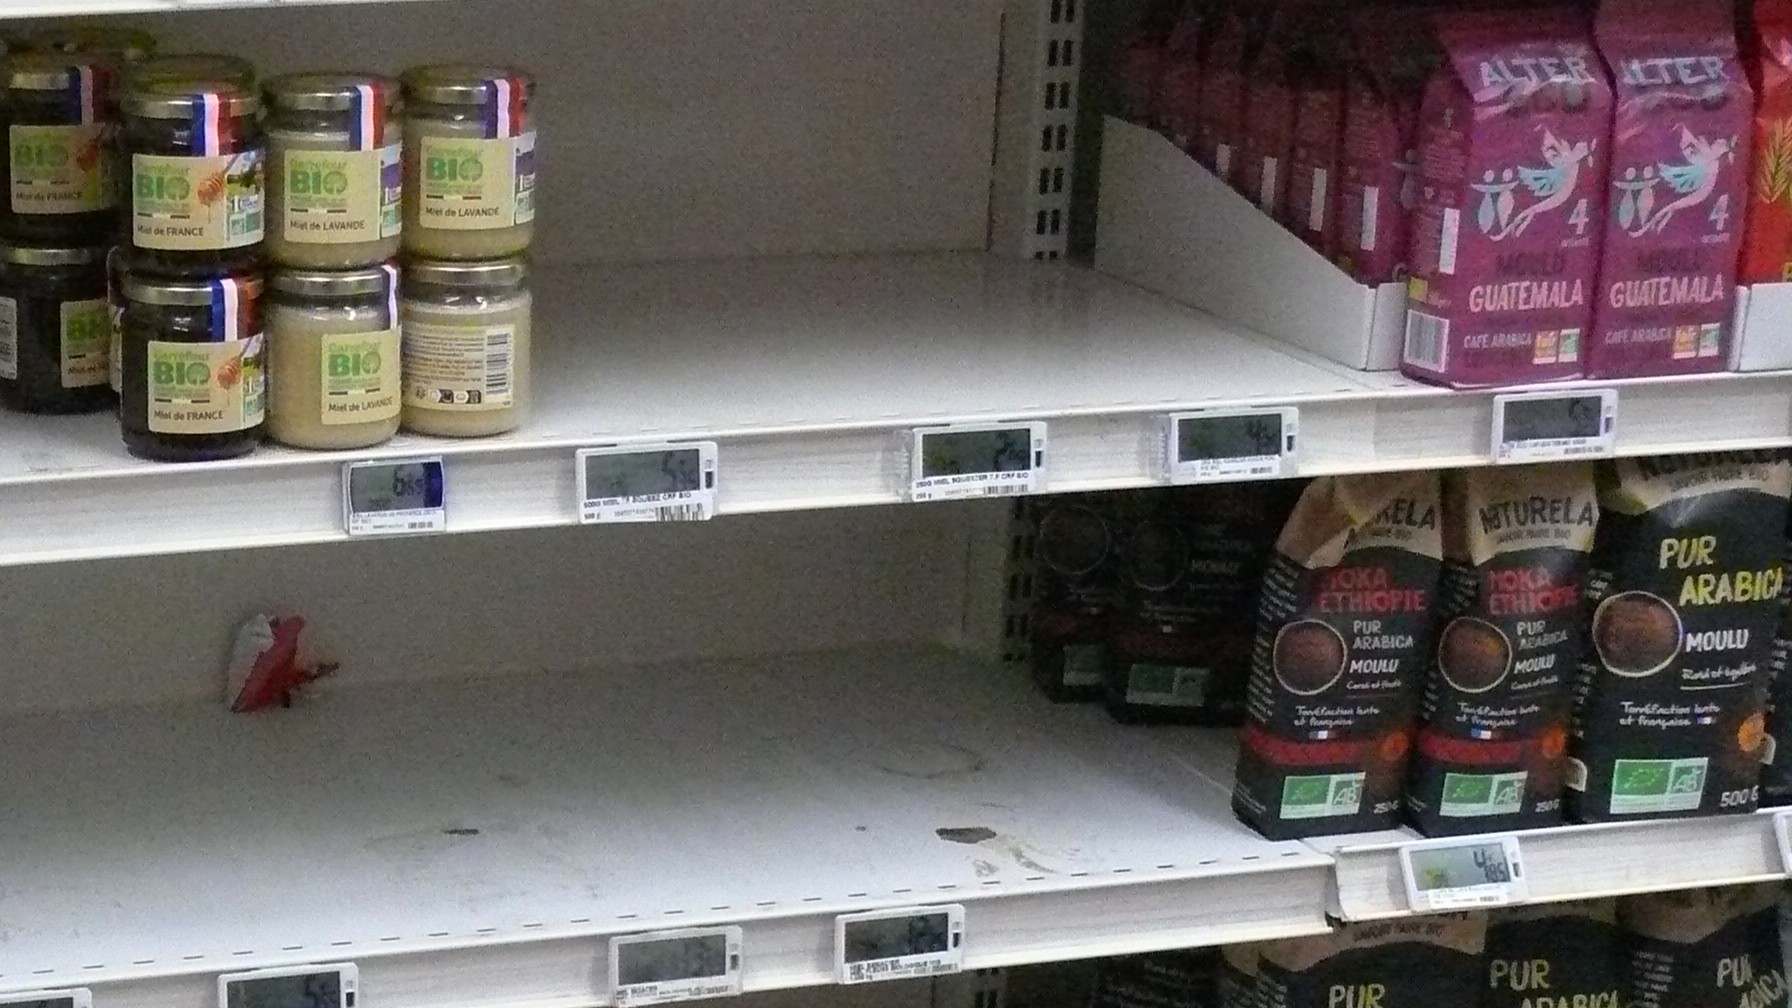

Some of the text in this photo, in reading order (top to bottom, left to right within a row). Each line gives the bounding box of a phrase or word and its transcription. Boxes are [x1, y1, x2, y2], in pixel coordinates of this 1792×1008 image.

[1480, 56, 1595, 87] ALTER
[426, 157, 483, 182] BIO
[136, 174, 190, 200] BIO
[290, 171, 347, 195] BIO
[426, 207, 499, 217] Miel de LAVANDE
[1568, 198, 1589, 234] 4
[1709, 194, 1729, 231] 4
[154, 225, 165, 235] de
[167, 226, 204, 237] FRANCE
[290, 220, 365, 230] Miel de LAVANDE
[1469, 278, 1584, 313] GUATEMALA
[1610, 271, 1724, 308] GUATEMALA
[1491, 332, 1532, 348] ARABICA
[154, 361, 211, 386] BIO
[328, 351, 382, 377] BIO
[154, 410, 224, 421] Miel de FRANCE
[328, 402, 347, 412] Miel
[349, 401, 360, 412] de
[1660, 535, 1717, 570] PUR
[1489, 567, 1551, 593] MOKA
[1679, 566, 1784, 607] ARABICA
[1318, 589, 1427, 614] ETHIOPIE
[1353, 620, 1382, 634] PUR
[1516, 620, 1546, 636] PUR
[1352, 635, 1414, 650] ARABICA
[1686, 629, 1749, 653] MOULU
[1349, 658, 1400, 674] MOULU
[1514, 654, 1556, 675] MOULU
[1296, 705, 1354, 716] Torréfaction
[1456, 714, 1469, 722] et
[1620, 701, 1721, 714] Torréfaction lente
[1294, 718, 1306, 726] et
[1619, 717, 1633, 725] et
[1720, 791, 1747, 807] 500
[1489, 958, 1550, 991] PUR
